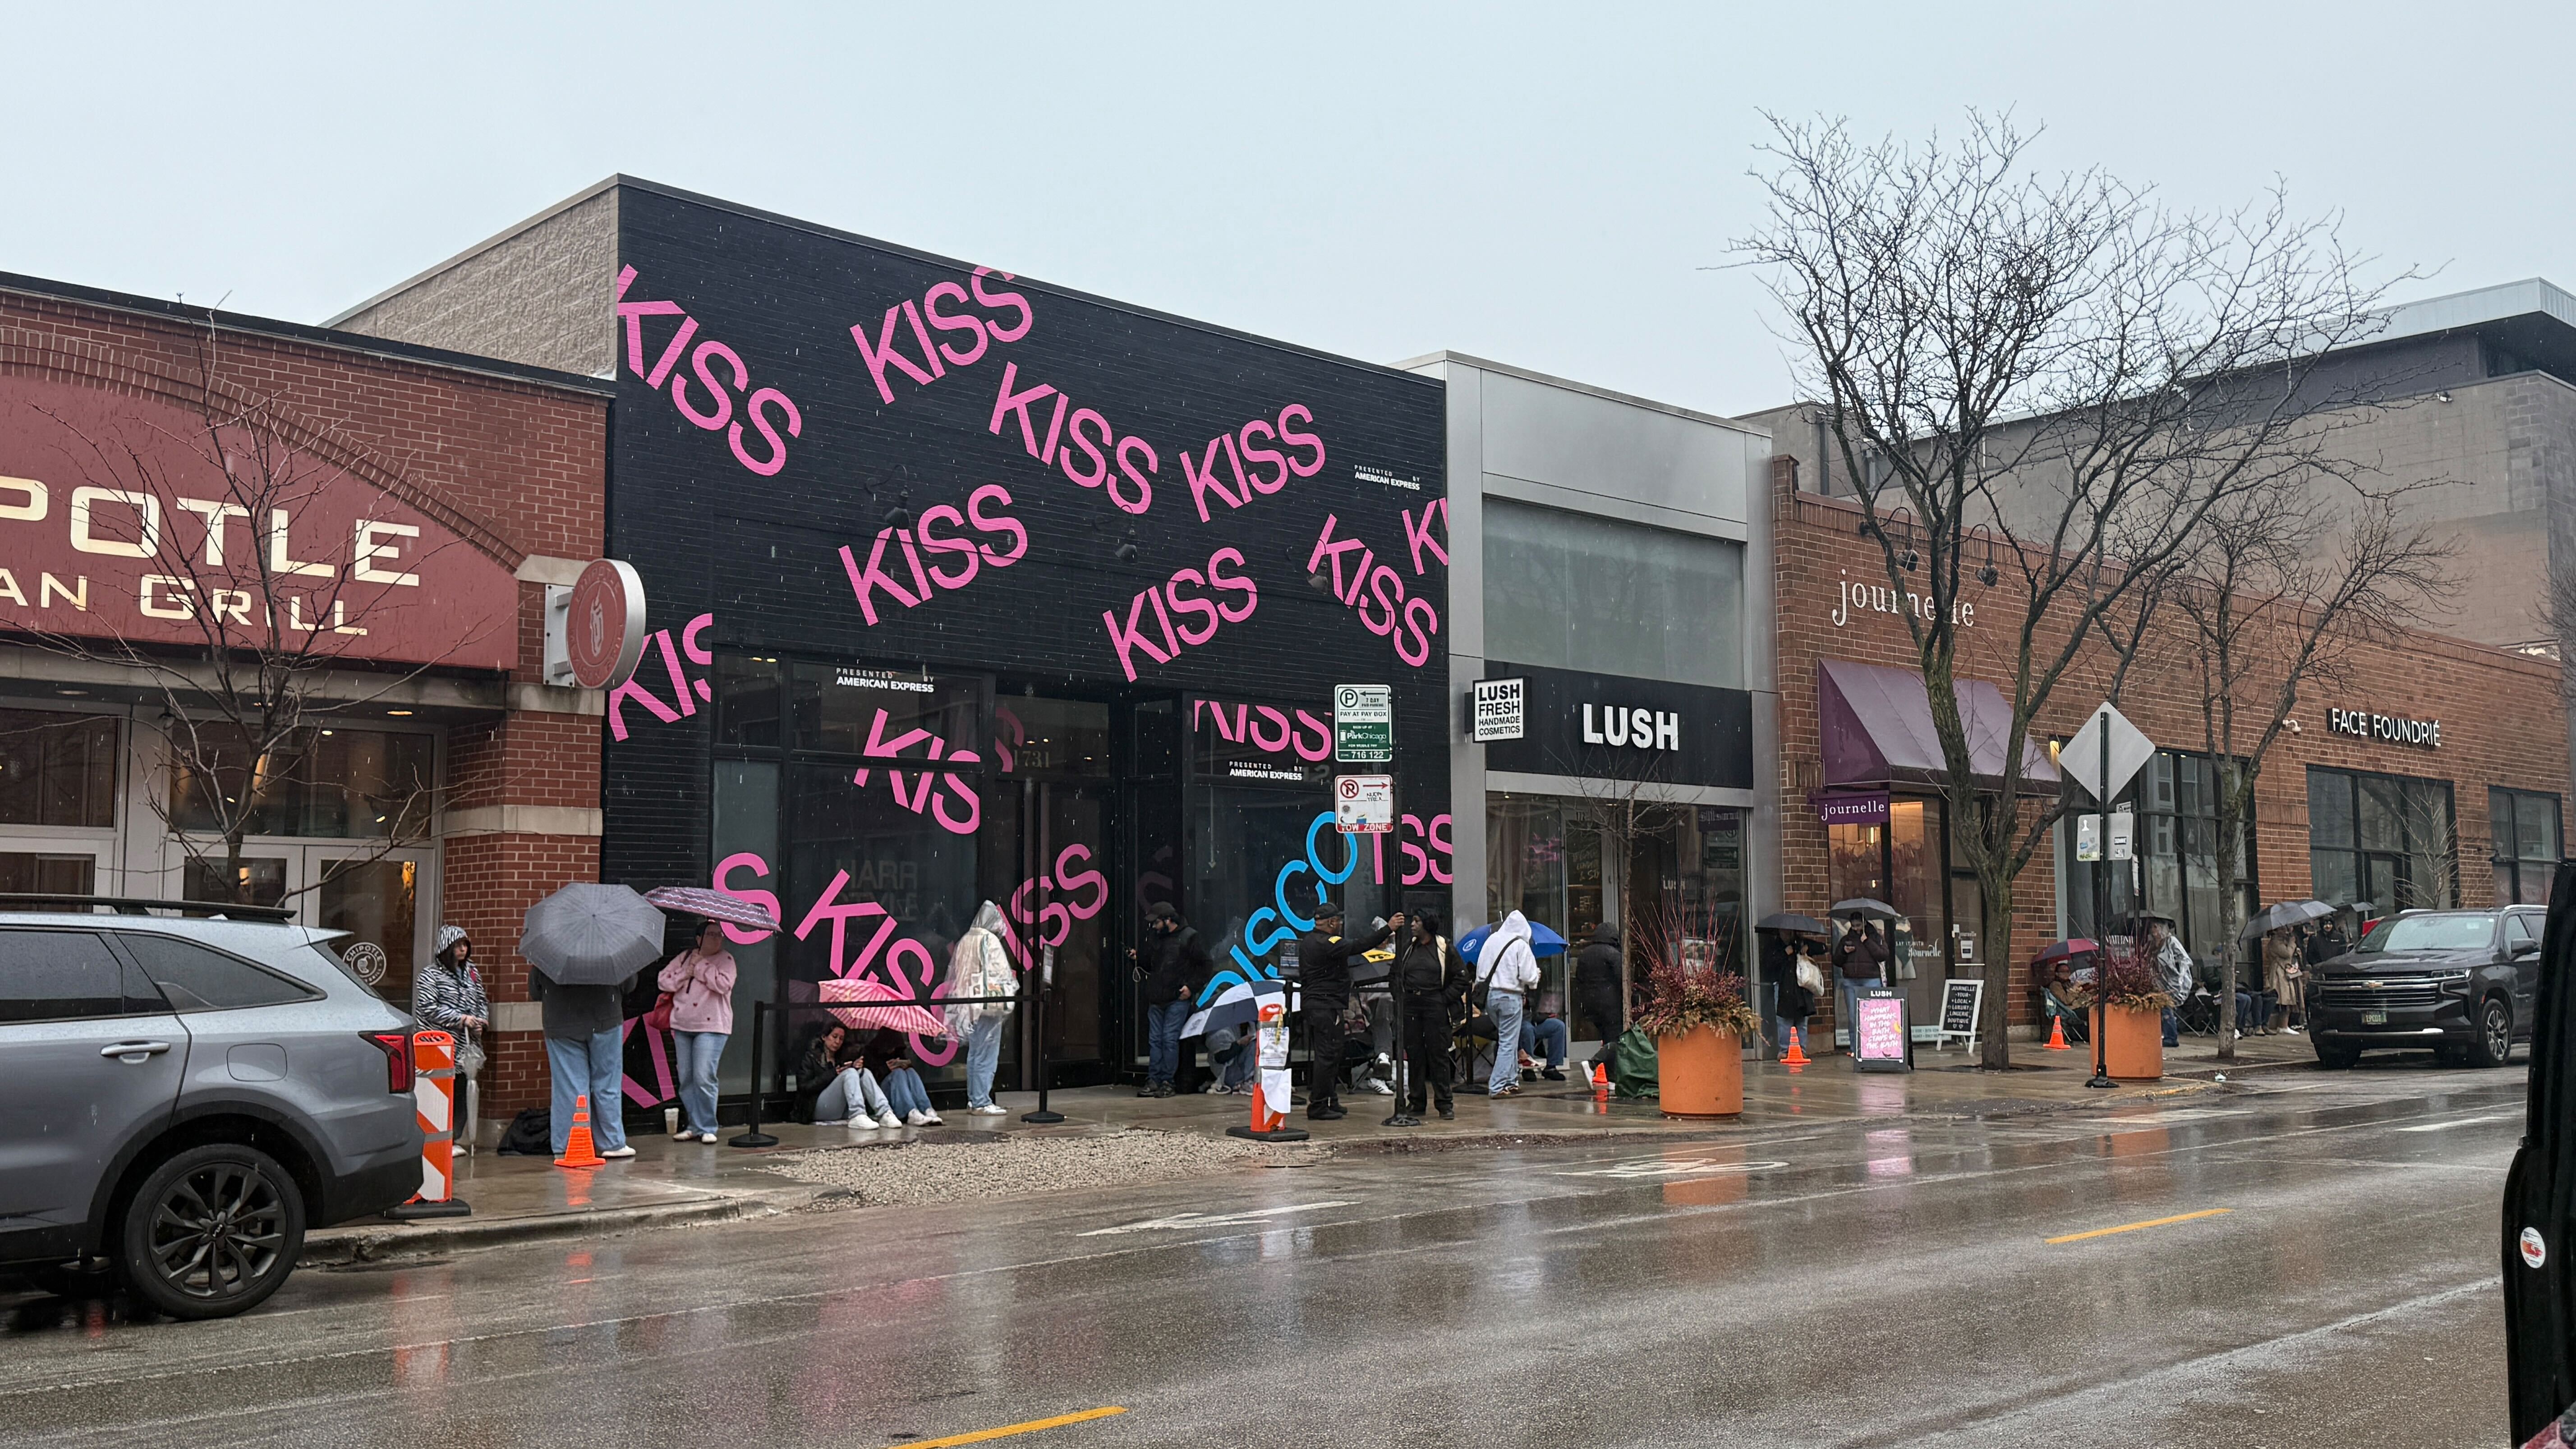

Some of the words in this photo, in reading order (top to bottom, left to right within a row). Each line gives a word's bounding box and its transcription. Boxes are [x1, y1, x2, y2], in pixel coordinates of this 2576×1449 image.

[850, 265, 1033, 405] KISS
[617, 263, 802, 476] KISS
[989, 361, 1158, 515] KISS
[1179, 404, 1325, 523] KISS
[1354, 472, 1389, 485] AMERICAN
[1391, 478, 1420, 490] EXPRESS
[838, 484, 1028, 627] KISS
[1306, 514, 1438, 667] KISS
[1832, 569, 1974, 627] journele
[1102, 547, 1257, 682] KISS
[836, 668, 893, 679] PRESENTED
[836, 676, 888, 690] AMERICAN
[891, 681, 934, 693] EXPRESS
[1479, 683, 1520, 702] LUSH
[1479, 700, 1520, 716] FRESH
[1479, 716, 1520, 726] HANDMADE
[1479, 726, 1520, 736] COSMETICS
[1583, 703, 1679, 751] LUSH
[2332, 708, 2367, 736] FACE
[2374, 714, 2441, 747] FOUNDRIÉ
[1229, 761, 1272, 769] PRESENTED
[1229, 768, 1268, 778] AMERICAN
[1270, 772, 1302, 781] EXPRESS
[1822, 801, 1885, 821] journelle
[995, 843, 1109, 972] ISS
[346, 945, 383, 962] CHIPOTLE
[1870, 1005, 1891, 1014] WHAT
